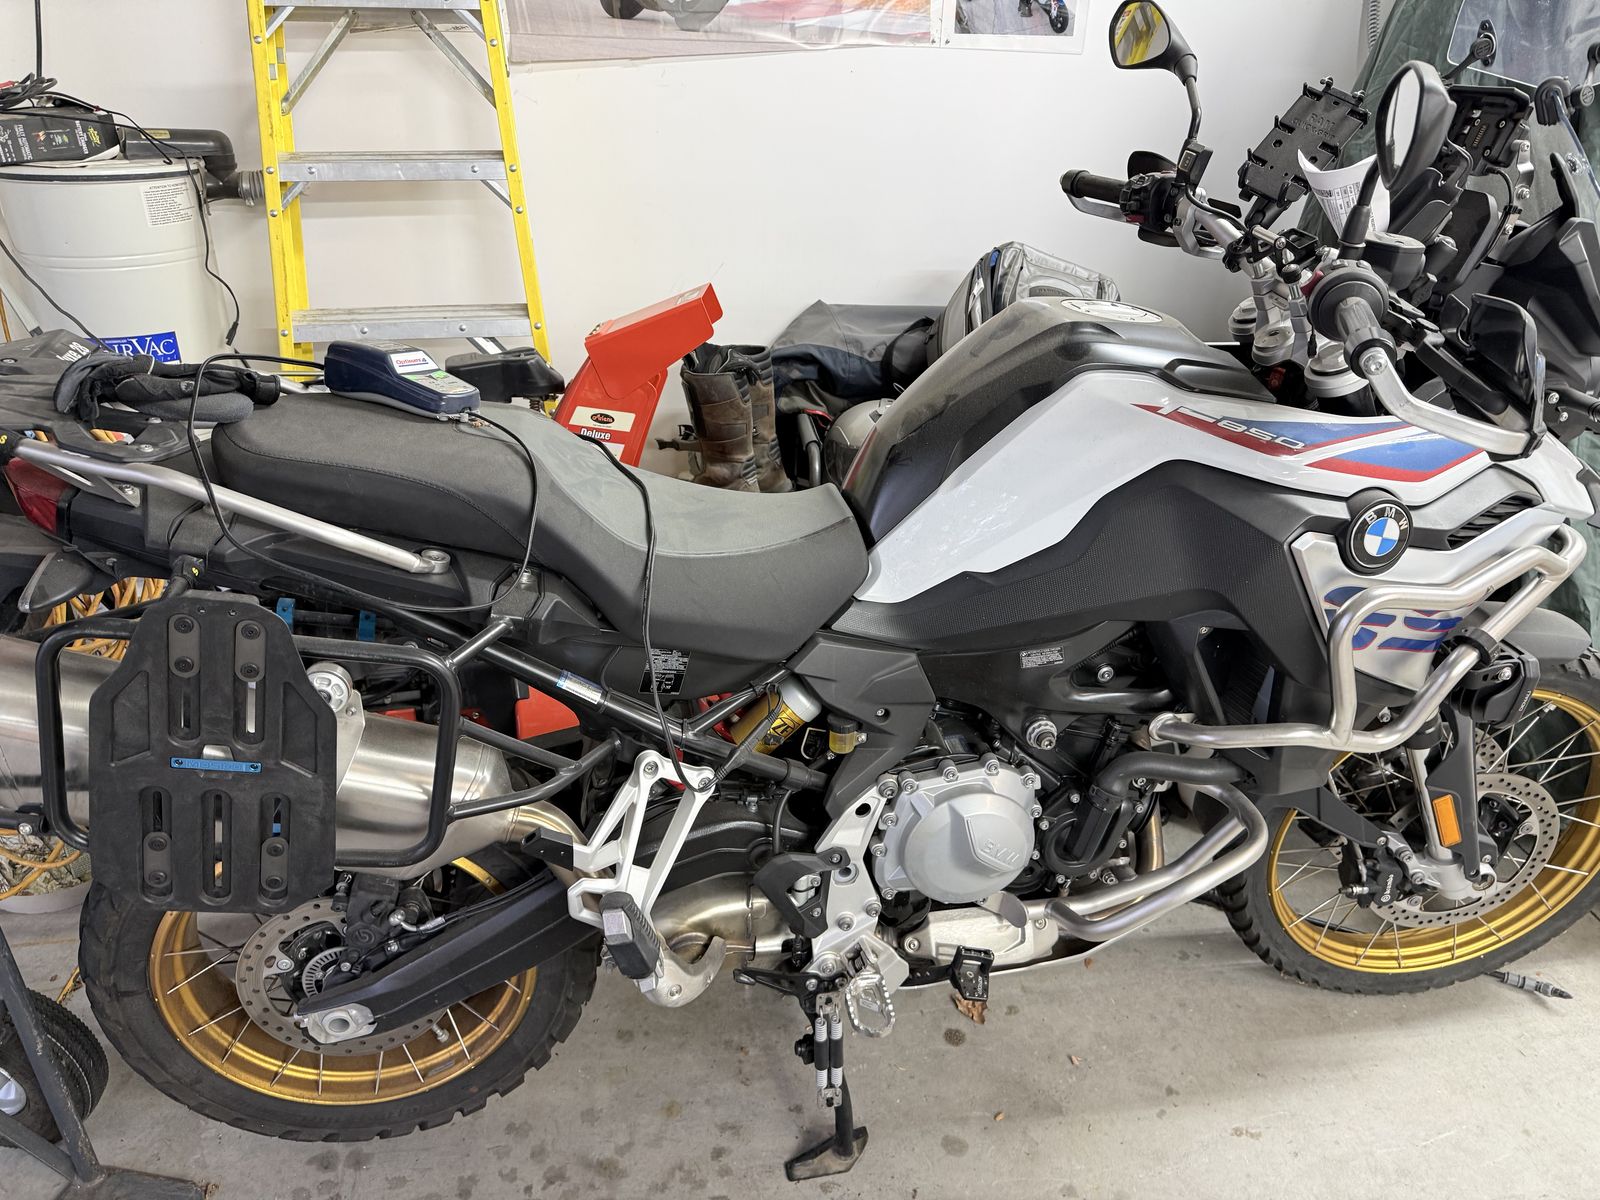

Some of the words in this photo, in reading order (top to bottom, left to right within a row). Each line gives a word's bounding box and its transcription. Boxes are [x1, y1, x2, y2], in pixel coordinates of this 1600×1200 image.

[16, 124, 26, 137] FULLY
[74, 120, 84, 137] BATTERY
[20, 136, 33, 160] AUTOMATIC
[78, 136, 89, 154] CHARGER
[112, 336, 176, 357] IRVAC
[580, 427, 611, 441] Deluxe
[1364, 506, 1408, 530] BMW
